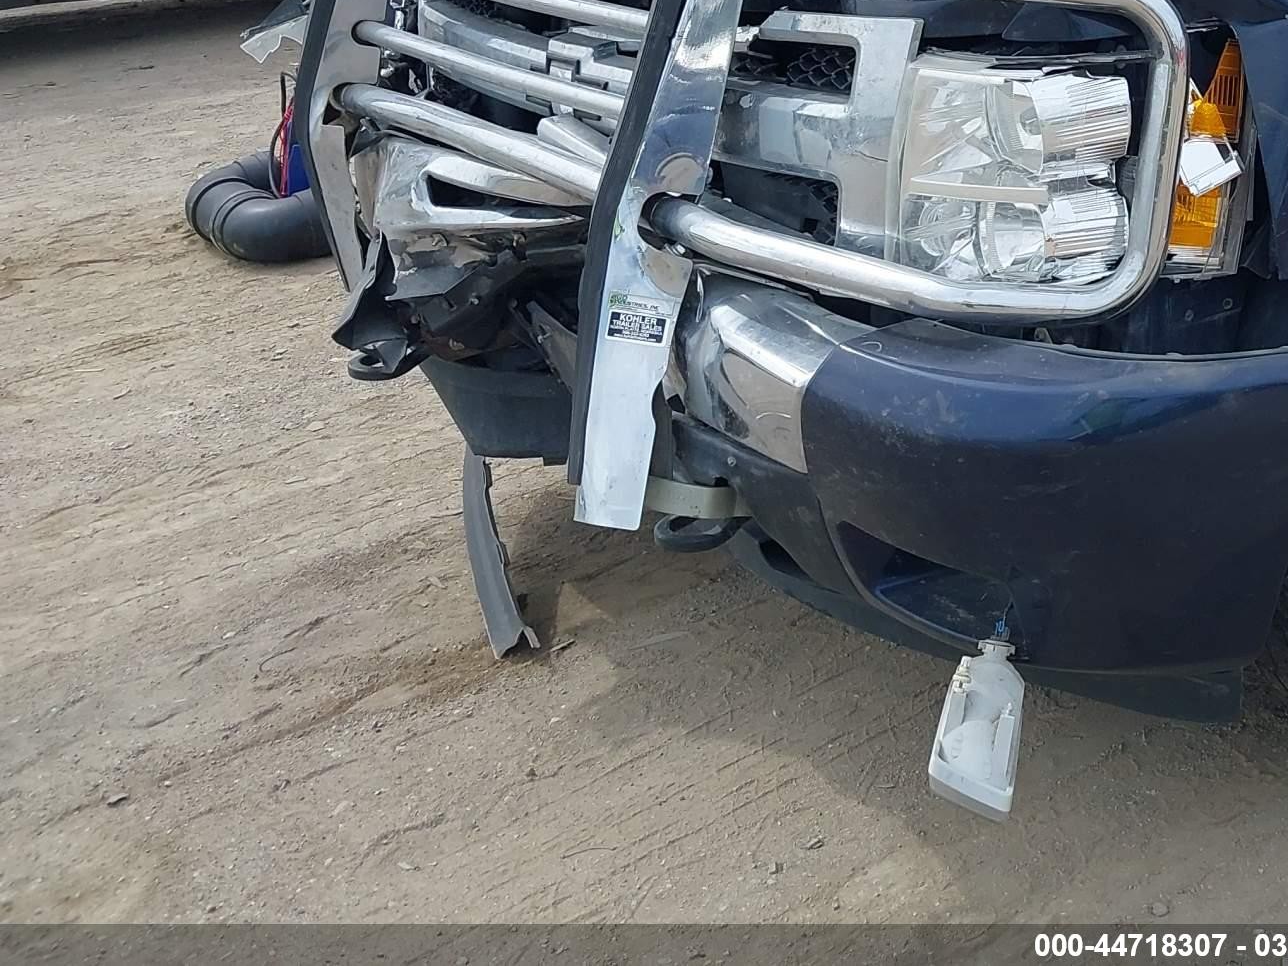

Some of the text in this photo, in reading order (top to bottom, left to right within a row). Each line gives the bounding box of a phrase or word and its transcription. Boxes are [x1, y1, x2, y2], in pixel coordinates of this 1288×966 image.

[619, 313, 658, 326] KOHLER
[612, 320, 640, 329] TRAILER
[641, 324, 663, 332] SALES
